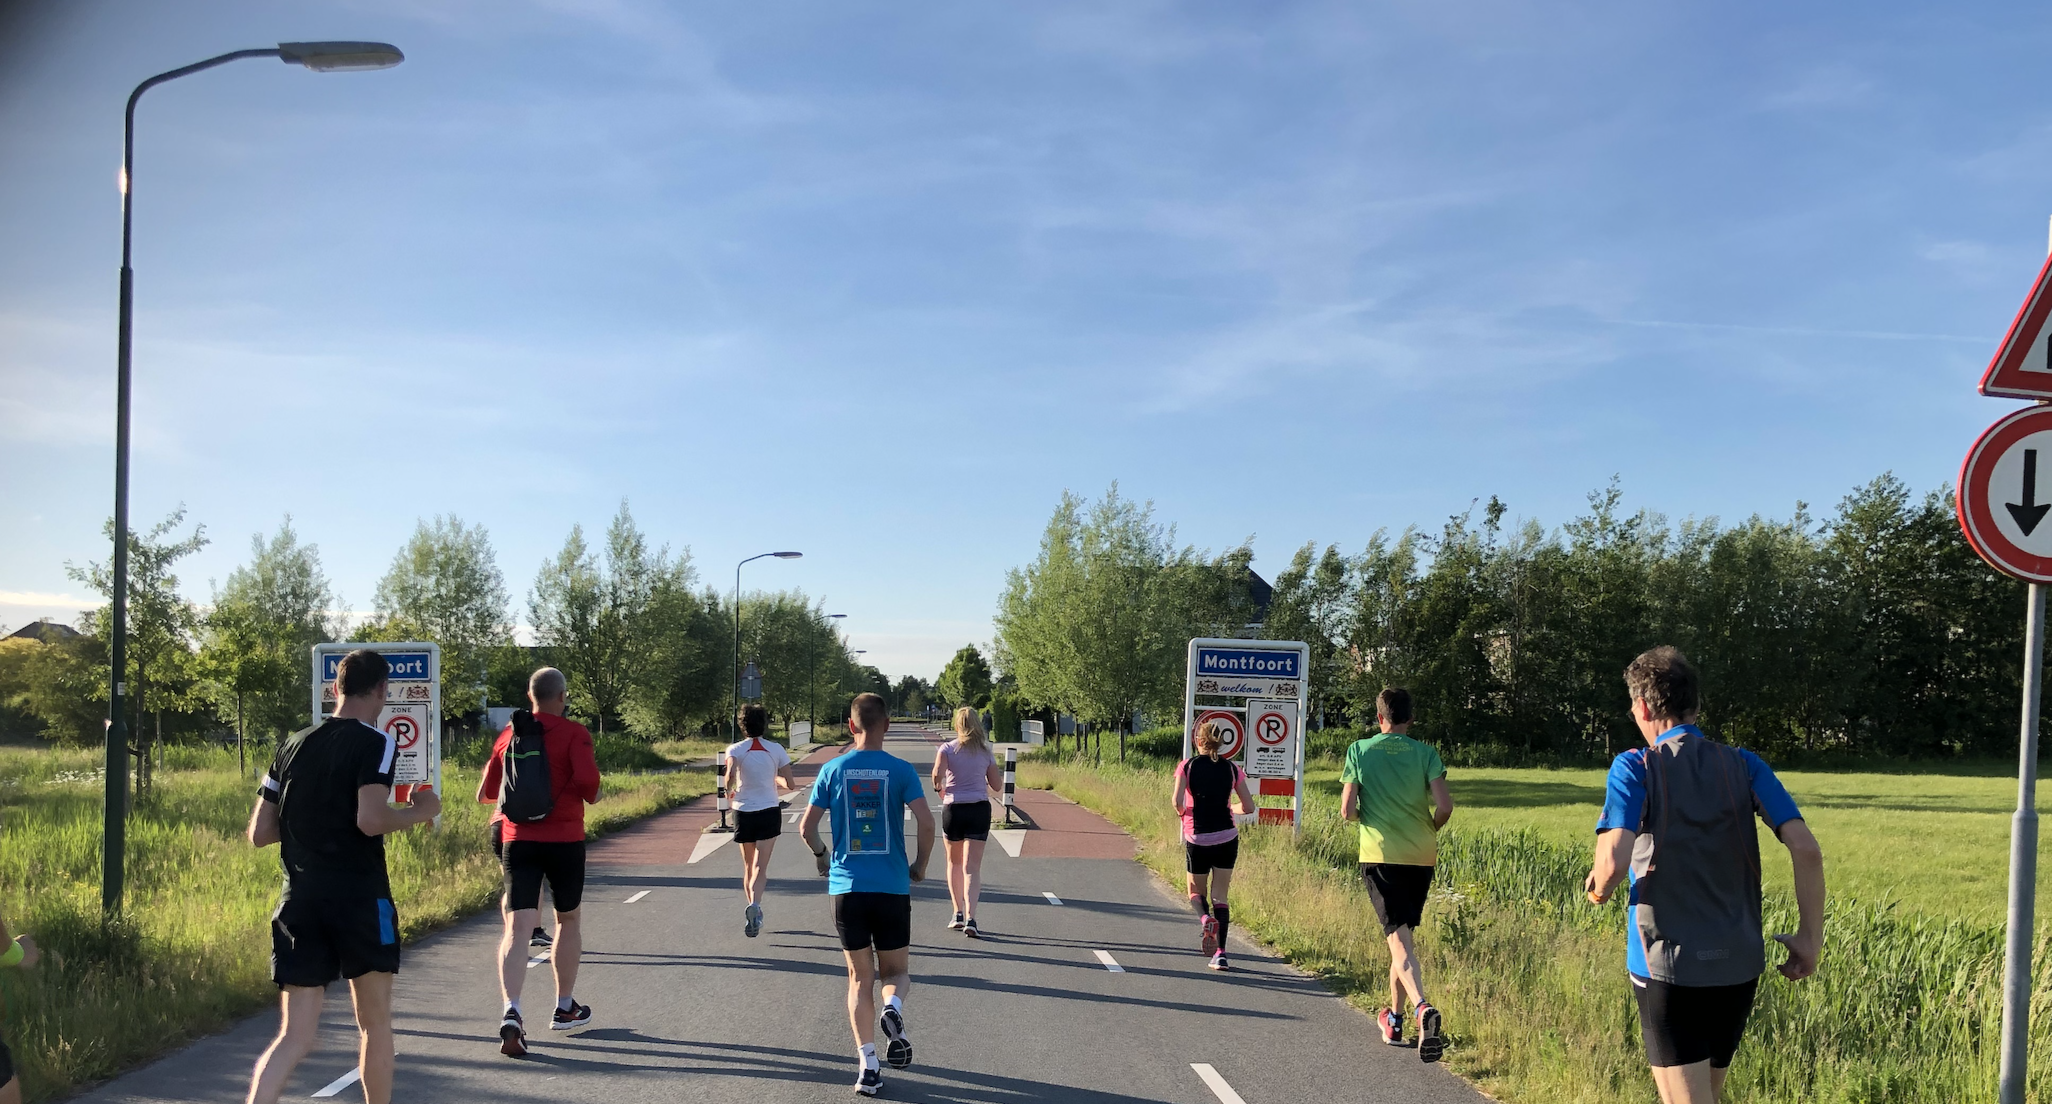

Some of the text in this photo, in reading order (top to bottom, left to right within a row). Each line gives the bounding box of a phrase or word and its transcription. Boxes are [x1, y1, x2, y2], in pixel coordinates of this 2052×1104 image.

[330, 659, 423, 674] Moort
[1204, 654, 1293, 672] Montfoort
[1220, 683, 1264, 694] welkom
